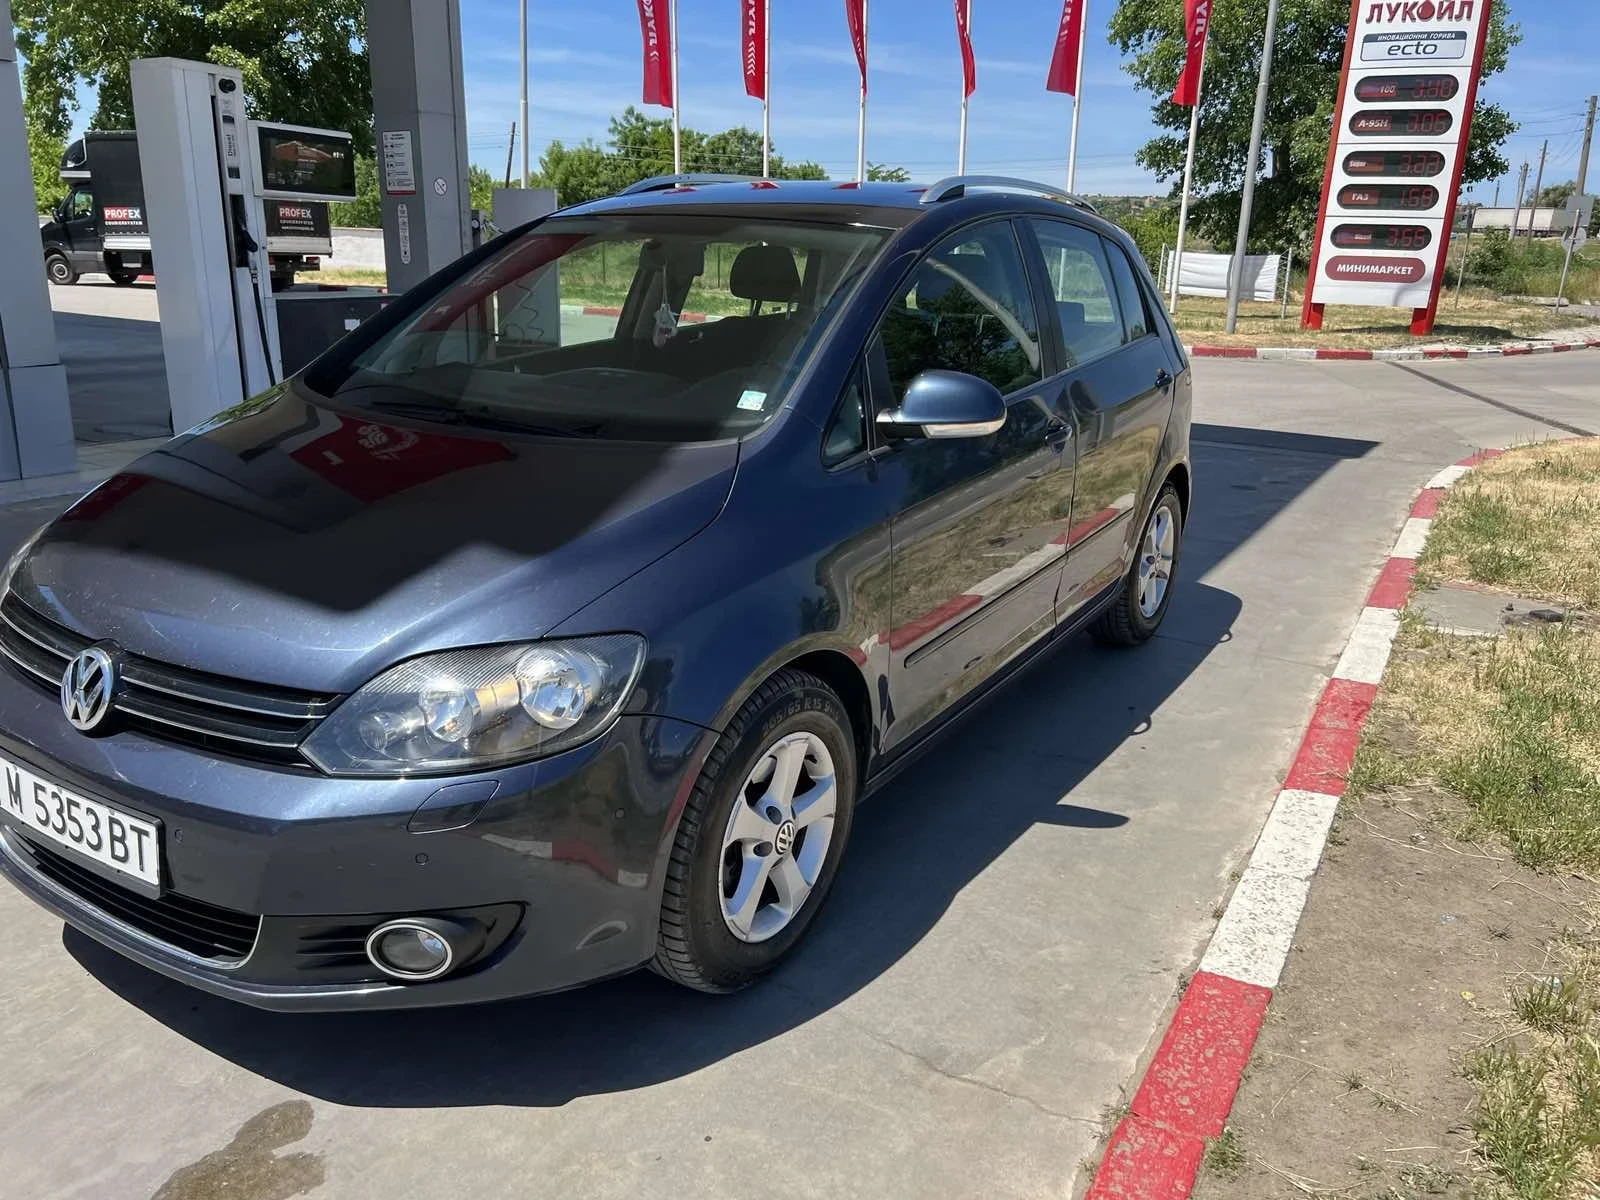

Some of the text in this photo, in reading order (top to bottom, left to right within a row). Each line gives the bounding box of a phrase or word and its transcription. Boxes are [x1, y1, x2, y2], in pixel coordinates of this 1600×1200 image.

[1377, 32, 1456, 42] ИНОВАЦИОННИ ГОРИВА
[1387, 41, 1438, 56] ecto
[1352, 193, 1370, 201] ГАЗ
[104, 208, 142, 219] PROFEX
[279, 207, 312, 219] PROFEX
[1336, 264, 1413, 276] МИНИМАРКЕТ
[6, 766, 150, 873] M 5353 BT
